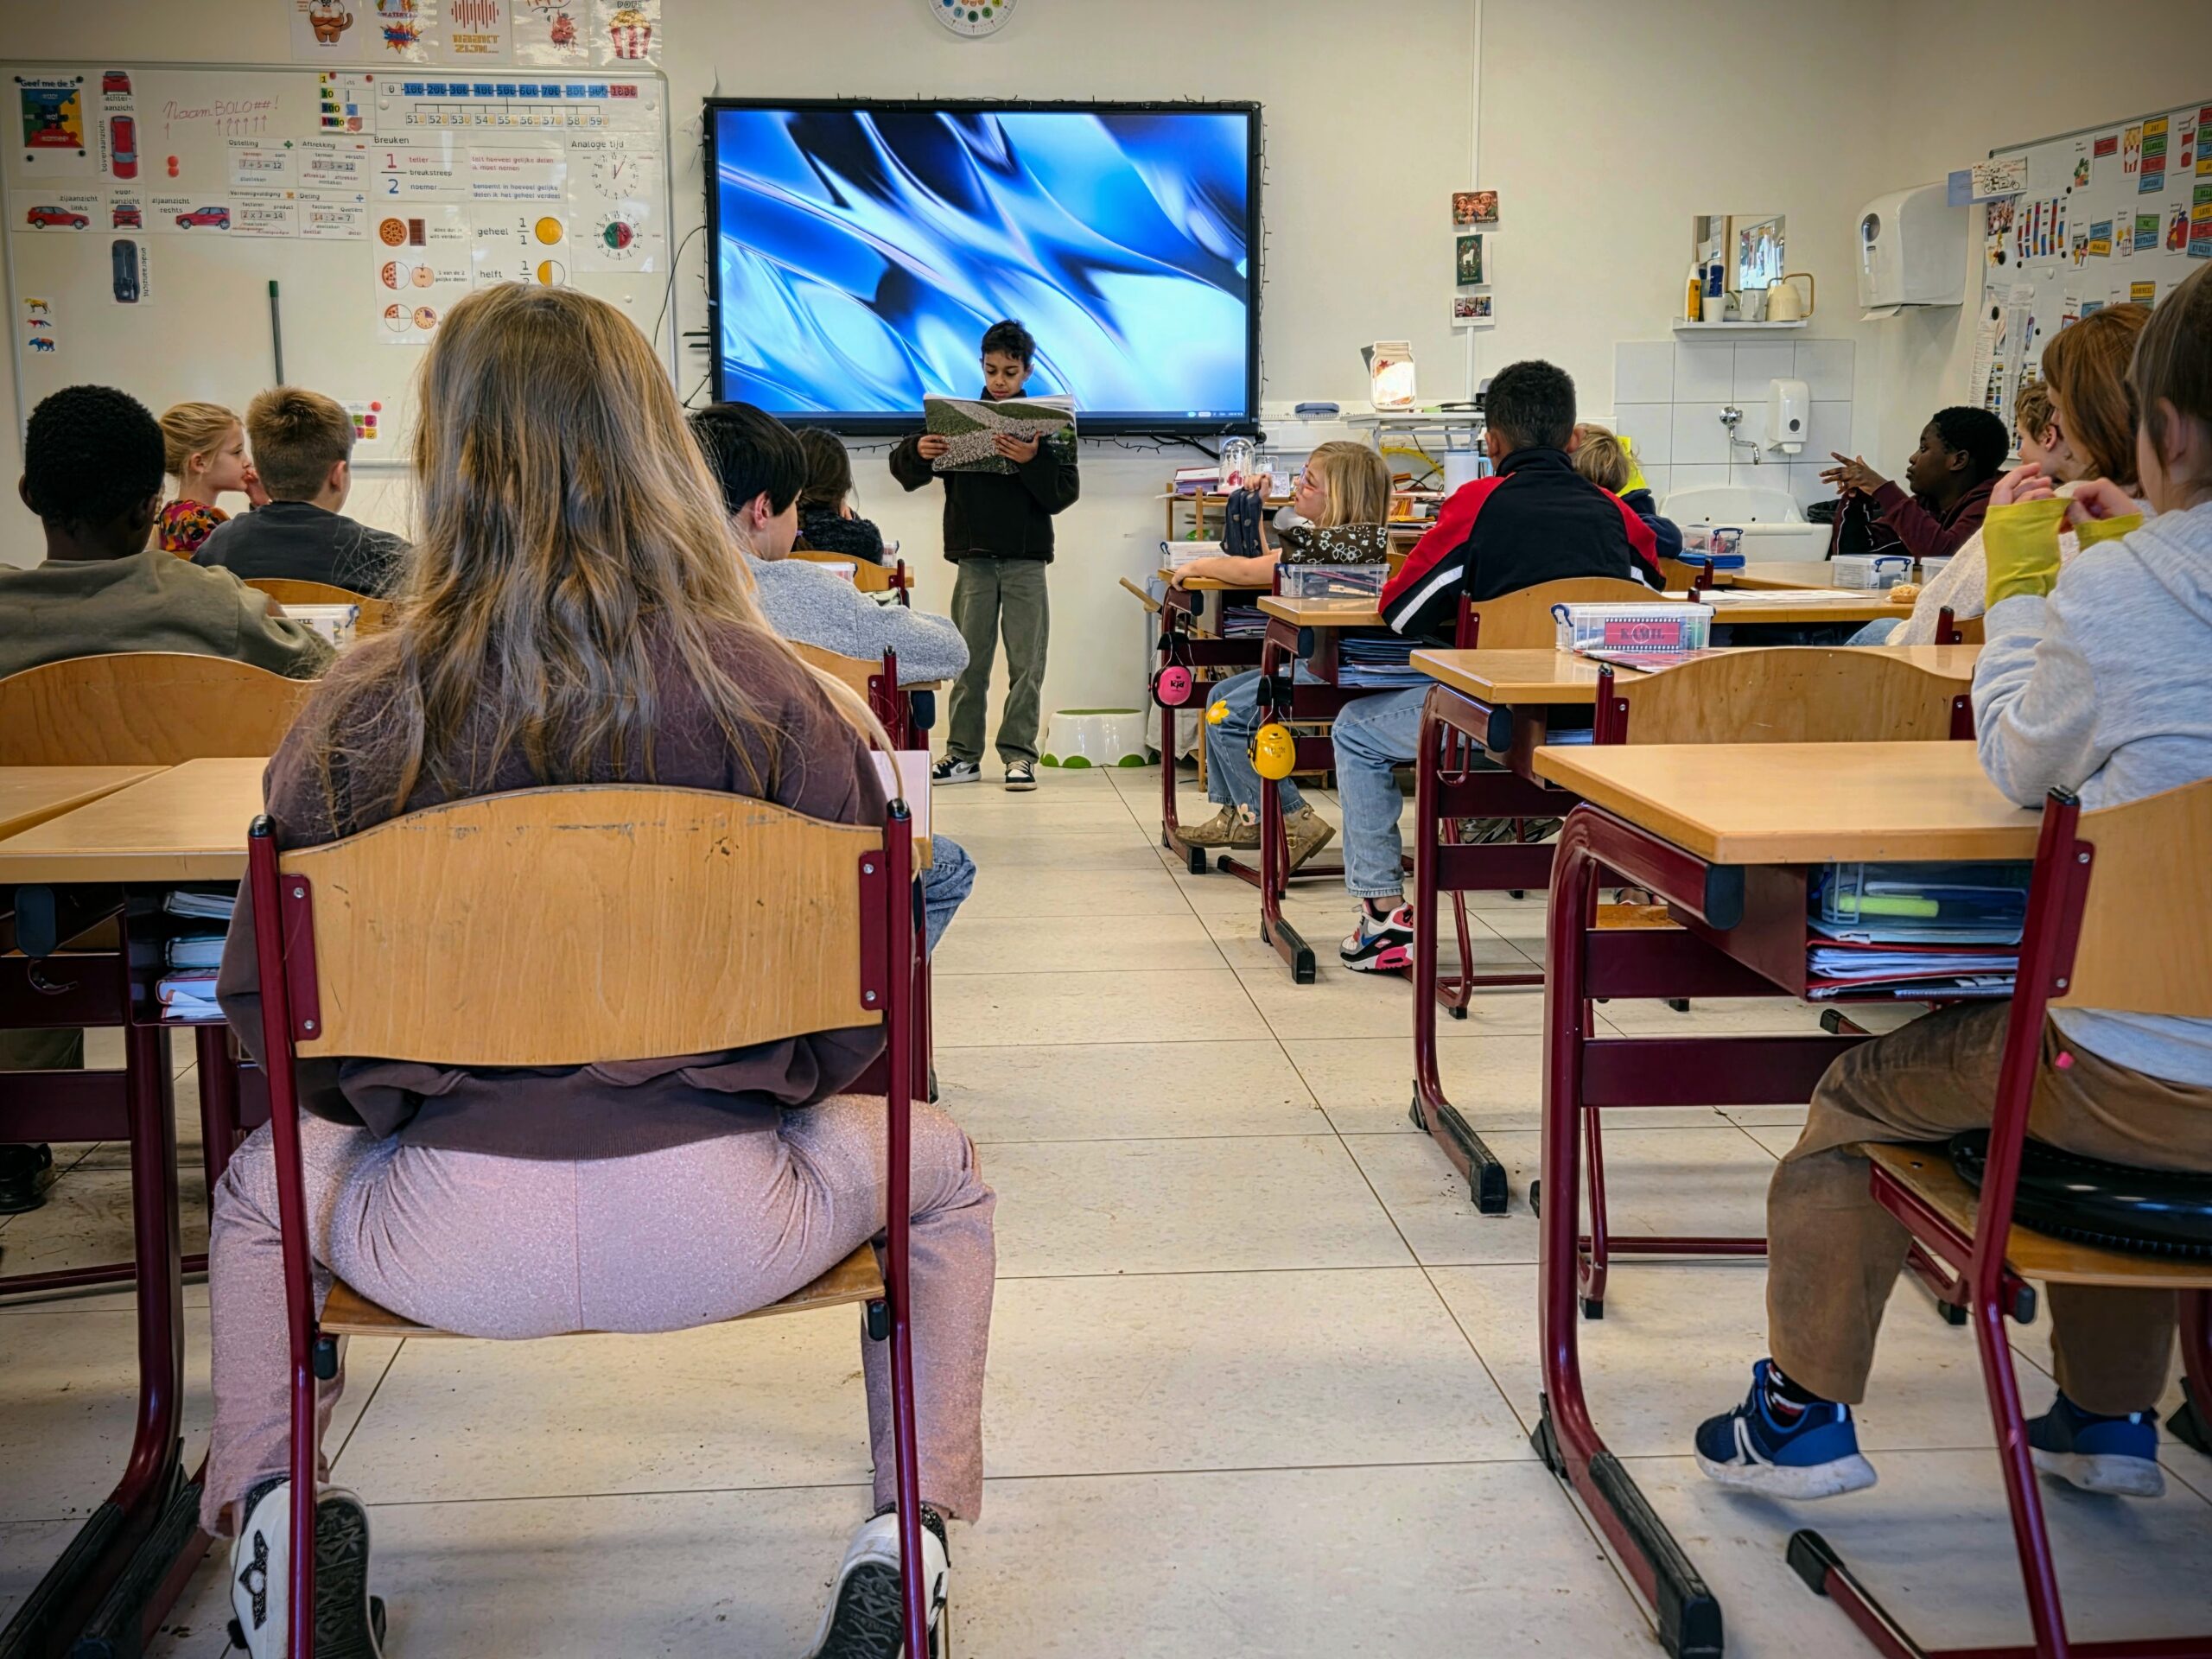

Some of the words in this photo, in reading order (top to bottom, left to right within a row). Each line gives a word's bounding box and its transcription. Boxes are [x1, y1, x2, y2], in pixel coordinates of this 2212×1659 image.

[389, 85, 395, 93] 0
[99, 119, 107, 172] bovenaanzicht
[302, 141, 335, 149] Aftrekking
[571, 141, 606, 149] Analoge
[610, 141, 624, 149] tijd
[386, 153, 397, 168] 1
[388, 179, 399, 194] 2
[519, 218, 526, 227] 1
[478, 228, 509, 237] geheel
[520, 235, 527, 245] 1
[522, 261, 529, 270] 1
[142, 247, 150, 297] onderaanzicht
[480, 270, 503, 278] helft
